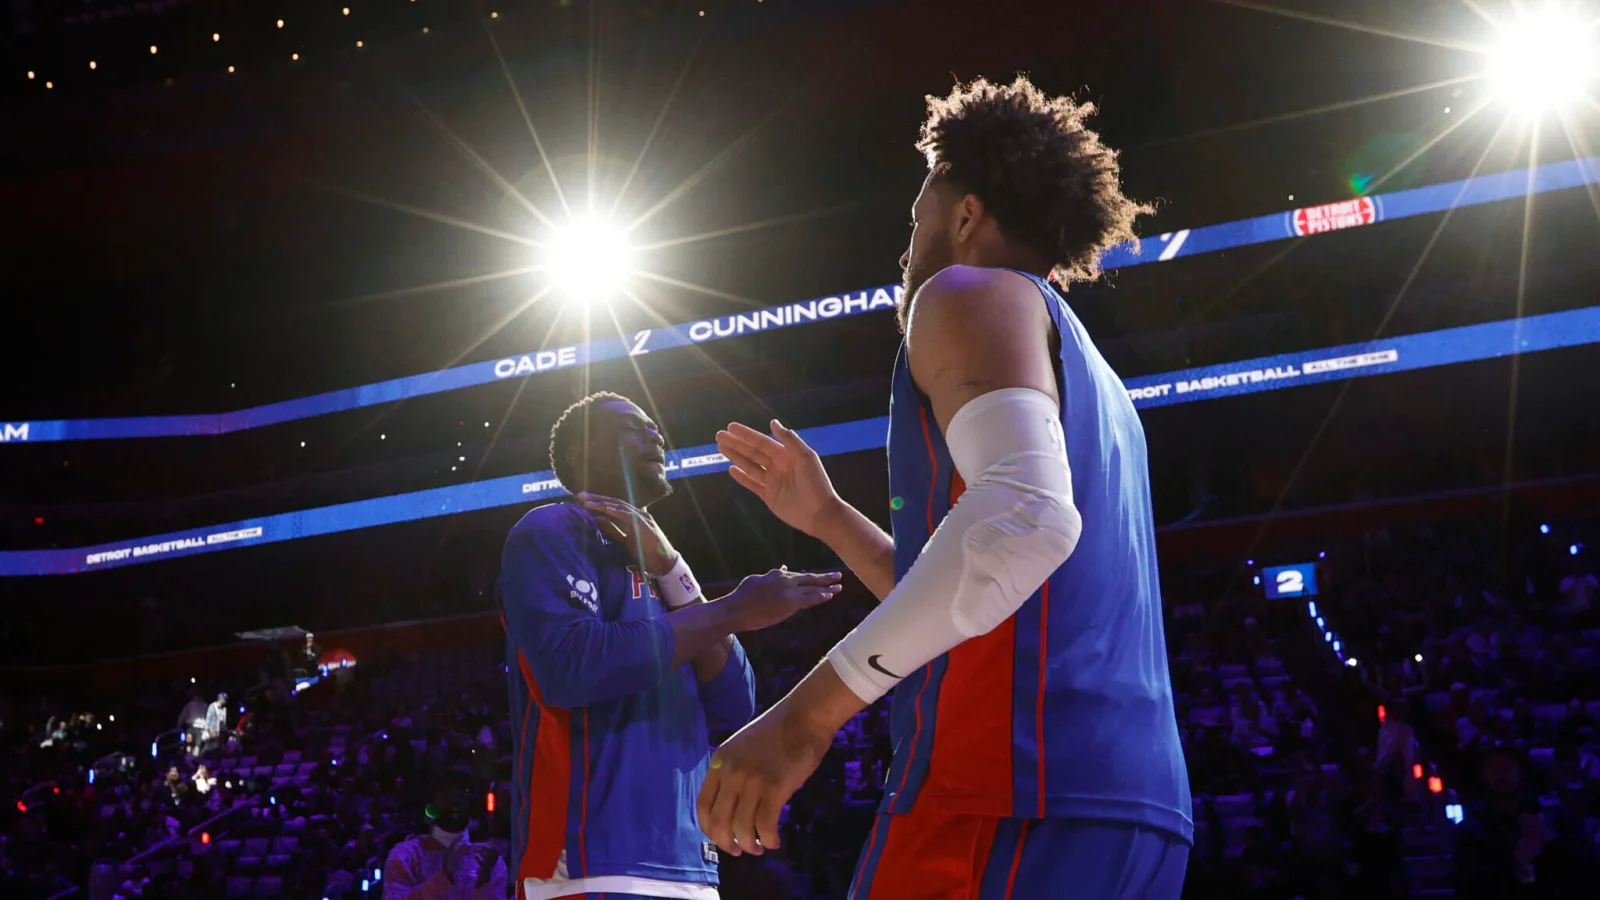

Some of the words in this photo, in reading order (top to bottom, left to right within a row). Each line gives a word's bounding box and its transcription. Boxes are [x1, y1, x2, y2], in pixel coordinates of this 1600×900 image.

[1306, 199, 1361, 220] DETROIT
[1308, 213, 1364, 235] PISTONS
[494, 346, 577, 378] CADE
[629, 329, 651, 356] 2
[1175, 364, 1301, 394] BASKETBALL
[86, 548, 131, 564] DETROIT
[132, 536, 206, 557] BASKETBALL
[1276, 570, 1304, 594] 2
